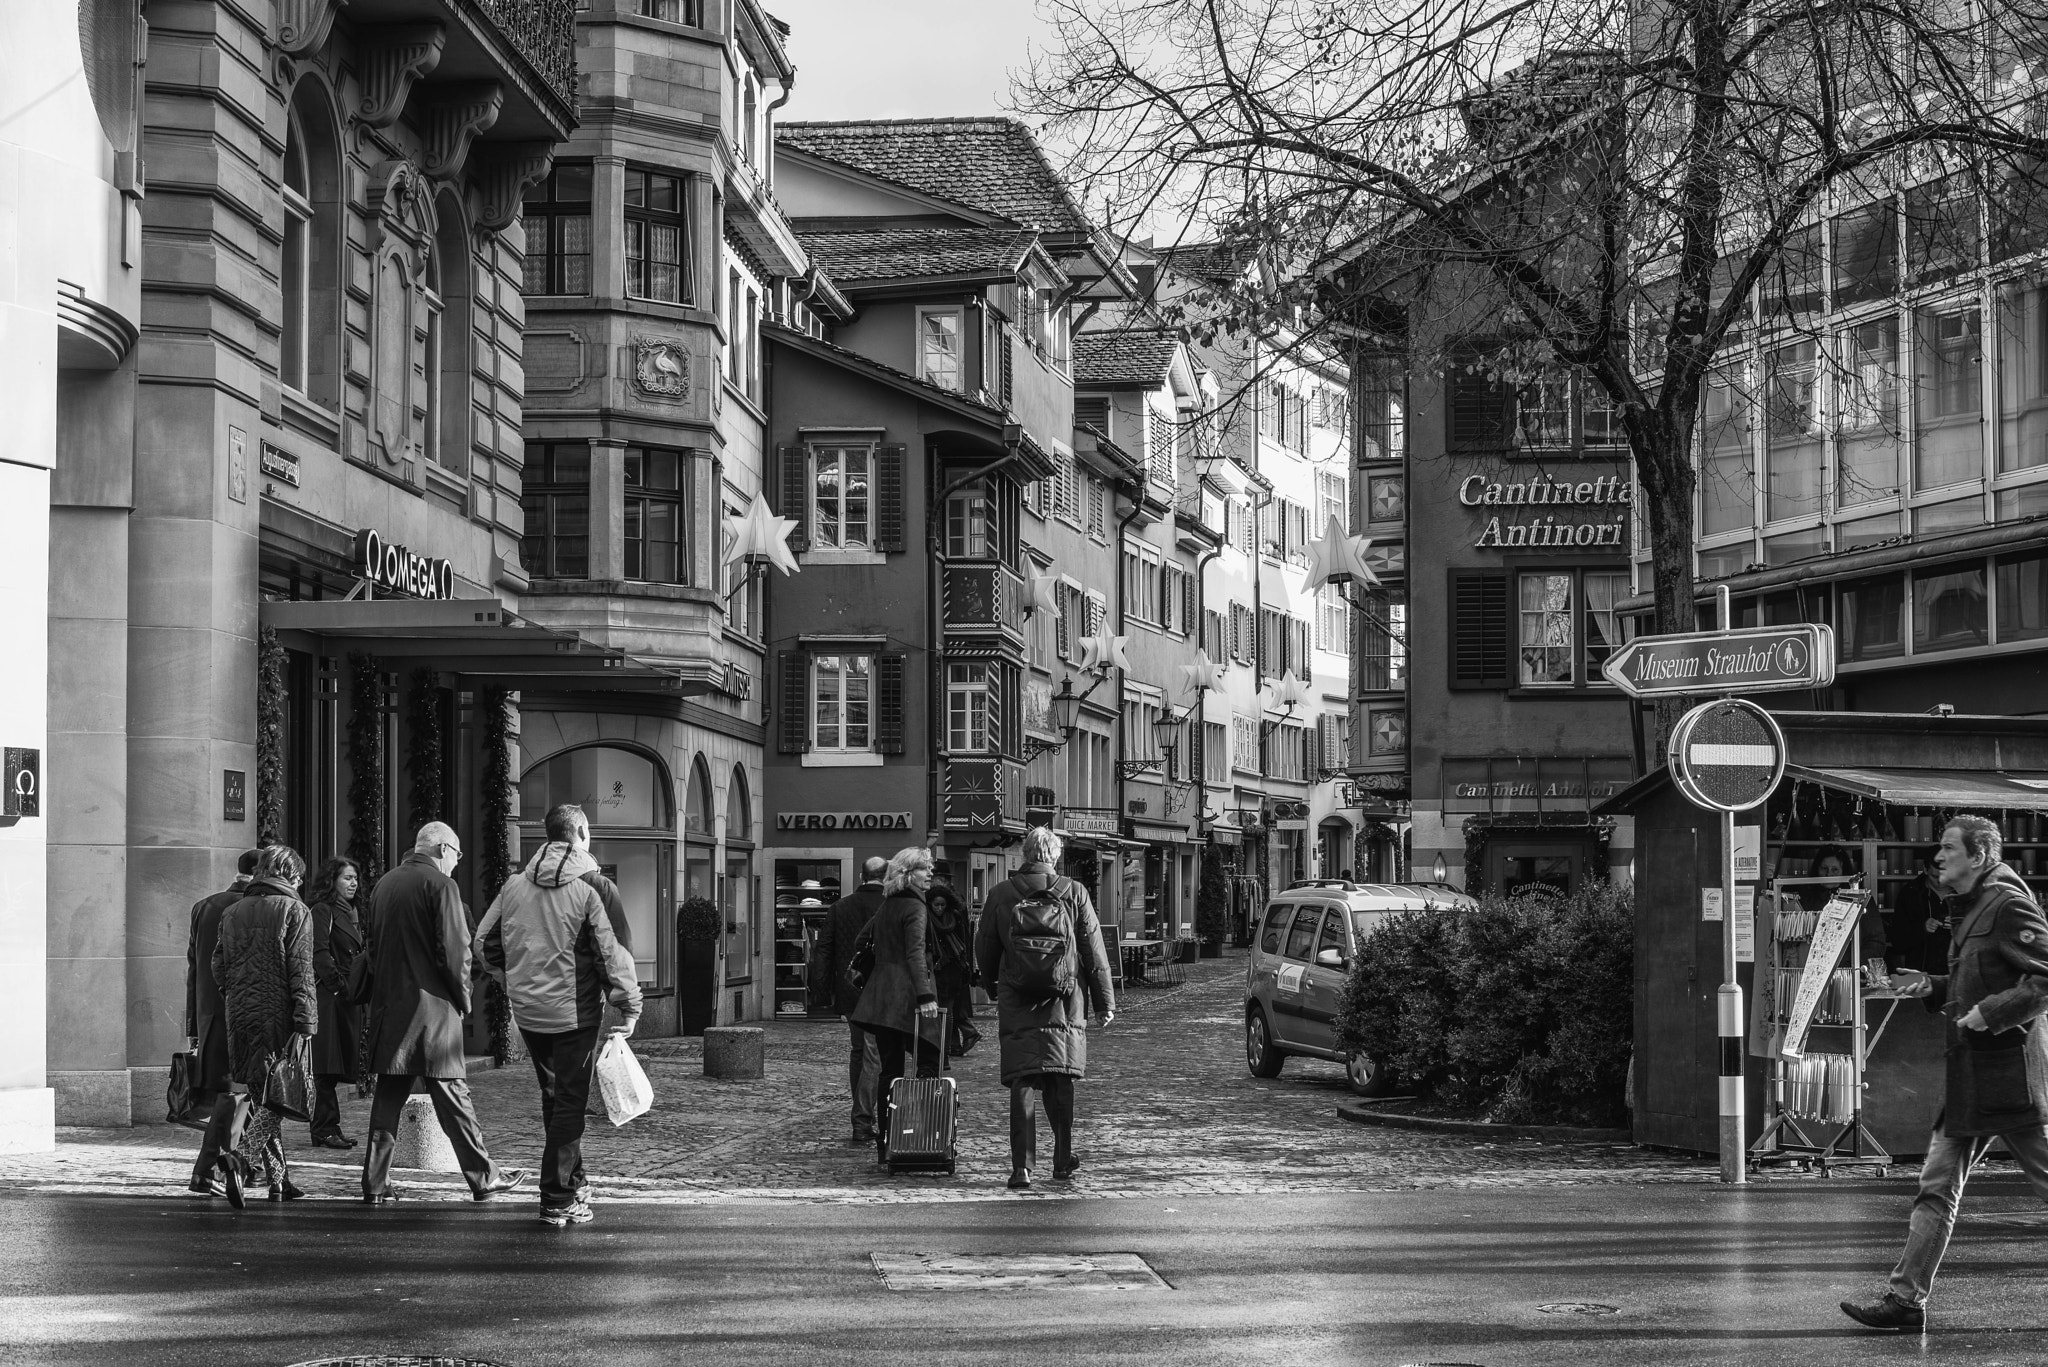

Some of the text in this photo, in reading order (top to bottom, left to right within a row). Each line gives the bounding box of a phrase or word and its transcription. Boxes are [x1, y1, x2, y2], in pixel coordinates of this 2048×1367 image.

[1459, 474, 1632, 505] Cantinetta
[1474, 515, 1624, 547] Antinori
[386, 545, 438, 600] OMEGA
[1634, 642, 1777, 681] Museum Strauhof
[779, 814, 908, 829] VERO MODA
[1066, 820, 1116, 832] JUICE MARKET
[1511, 880, 1566, 898] Cantinetta
